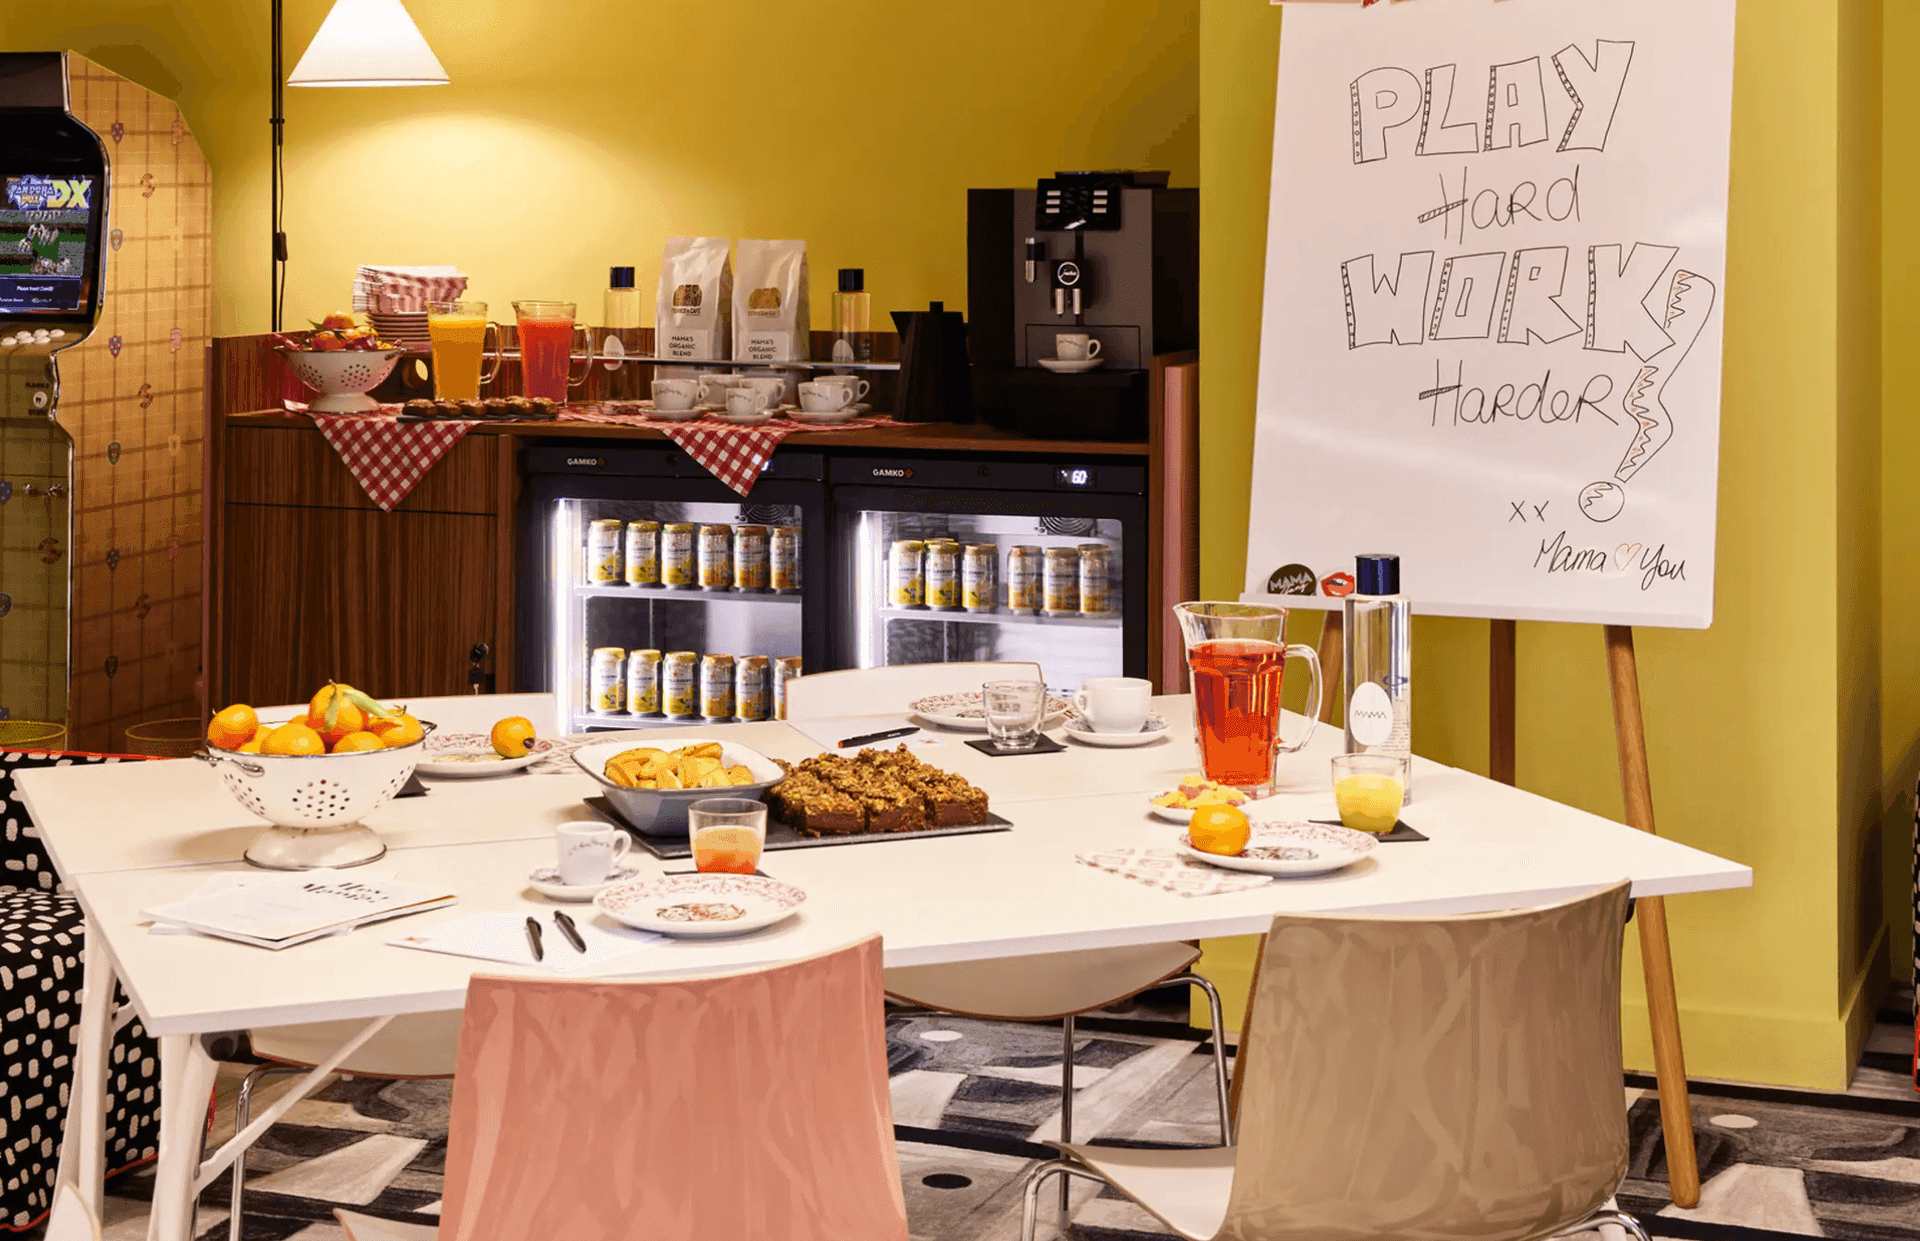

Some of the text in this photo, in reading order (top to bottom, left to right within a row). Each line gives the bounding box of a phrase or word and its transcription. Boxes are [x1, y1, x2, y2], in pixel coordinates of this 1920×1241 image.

[1350, 39, 1635, 164] PLAY
[45, 179, 92, 208] DX
[1341, 242, 1679, 363] WORK
[567, 458, 597, 466] GAMKO
[872, 469, 905, 477] GAMKO
[1533, 530, 1686, 591] Mama You
[1270, 571, 1313, 591] MAMA
